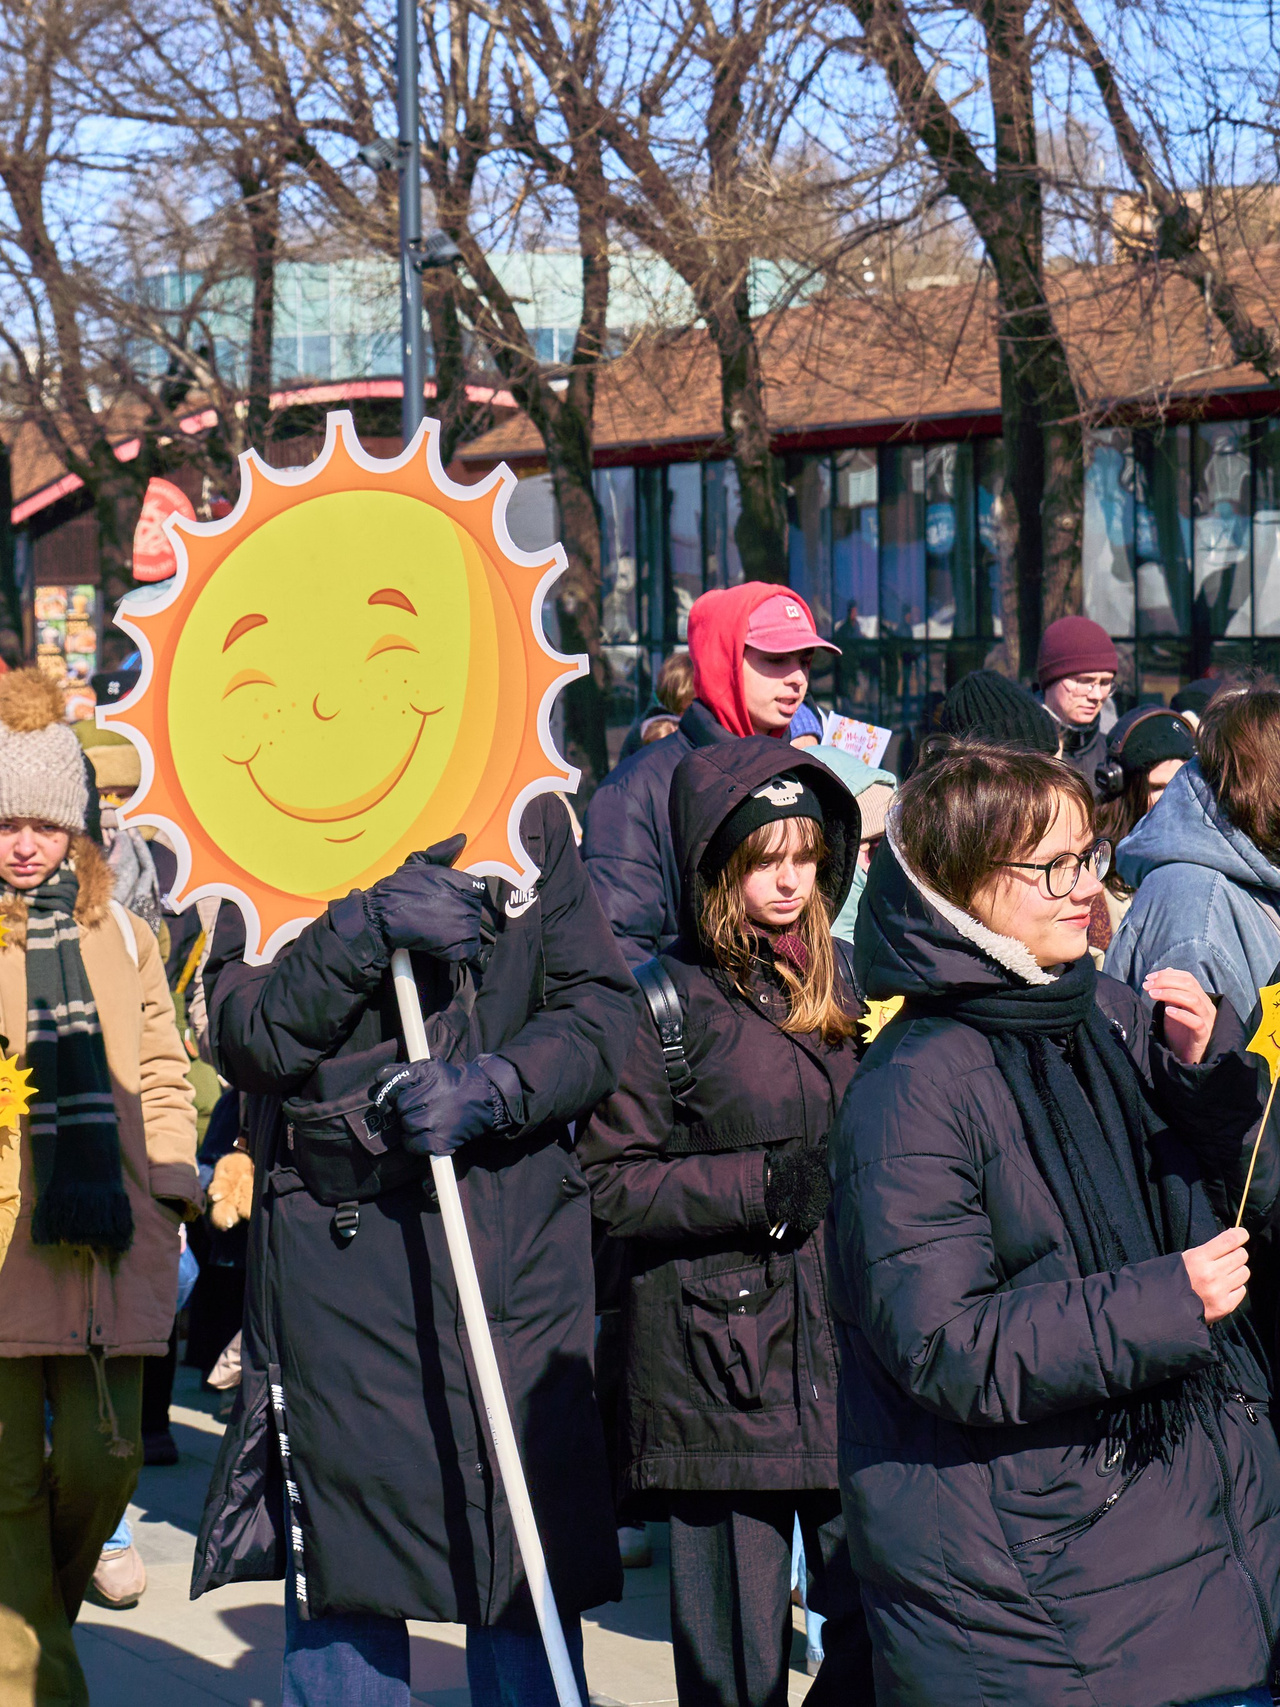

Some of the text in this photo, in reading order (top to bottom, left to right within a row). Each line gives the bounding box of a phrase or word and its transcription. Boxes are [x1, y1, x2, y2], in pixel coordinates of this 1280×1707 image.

[510, 887, 535, 905] NIKE
[375, 1069, 410, 1108] NORDSKI
[270, 1383, 286, 1411] NIKE
[278, 1432, 291, 1457] NIKE
[286, 1479, 301, 1504] NIKE
[291, 1525, 304, 1552] NIKE
[296, 1573, 307, 1602] NIKE
